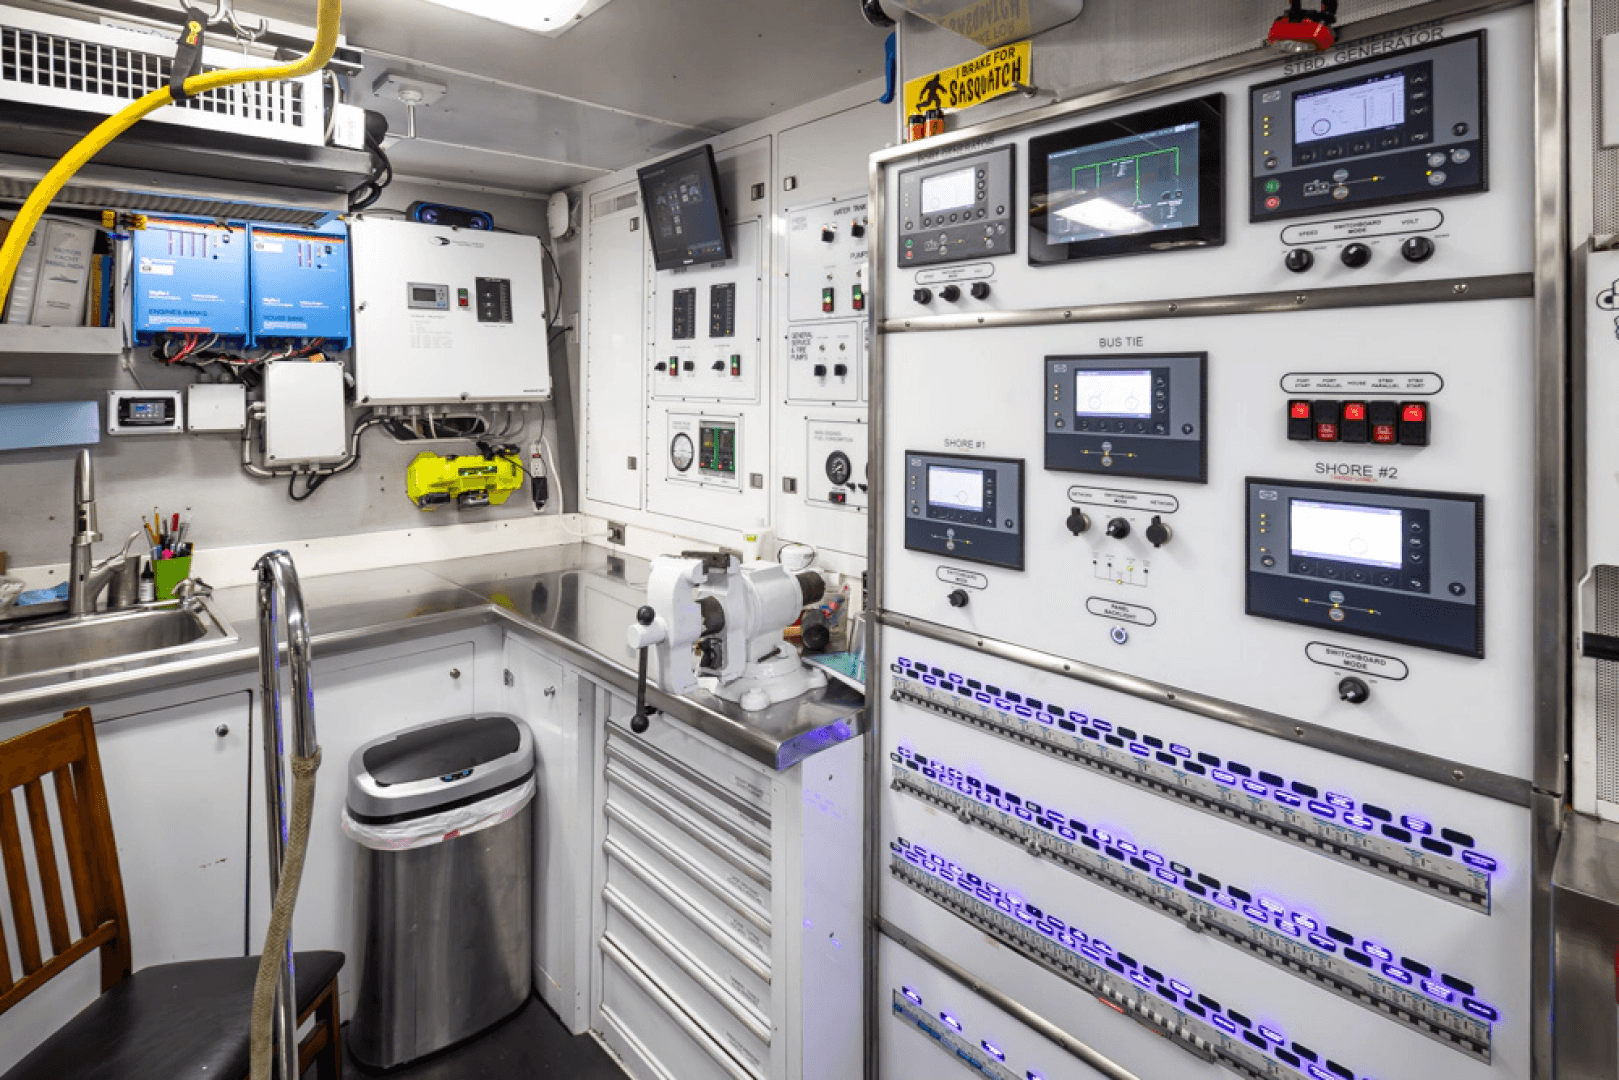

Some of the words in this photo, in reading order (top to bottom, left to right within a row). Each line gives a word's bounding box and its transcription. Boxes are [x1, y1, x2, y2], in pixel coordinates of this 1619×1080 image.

[1284, 56, 1330, 76] STBD.
[1334, 26, 1445, 63] GENERATOR
[962, 54, 992, 77] BRAKE
[993, 46, 1016, 64] FOR
[949, 55, 1022, 107] SASQUATCH
[1333, 219, 1382, 231] SWITCHBOARD
[1401, 218, 1419, 226] VOLT
[1099, 338, 1123, 348] BUS
[1125, 336, 1144, 347] TIE
[944, 438, 974, 449] SHORE
[1315, 461, 1374, 478] SHORE
[1377, 466, 1398, 480] #2
[1104, 608, 1137, 619] BACKLIGHT
[1111, 603, 1129, 612] PANEL
[1325, 648, 1387, 667] SWITCHBOARD
[1343, 659, 1368, 670] MODE
